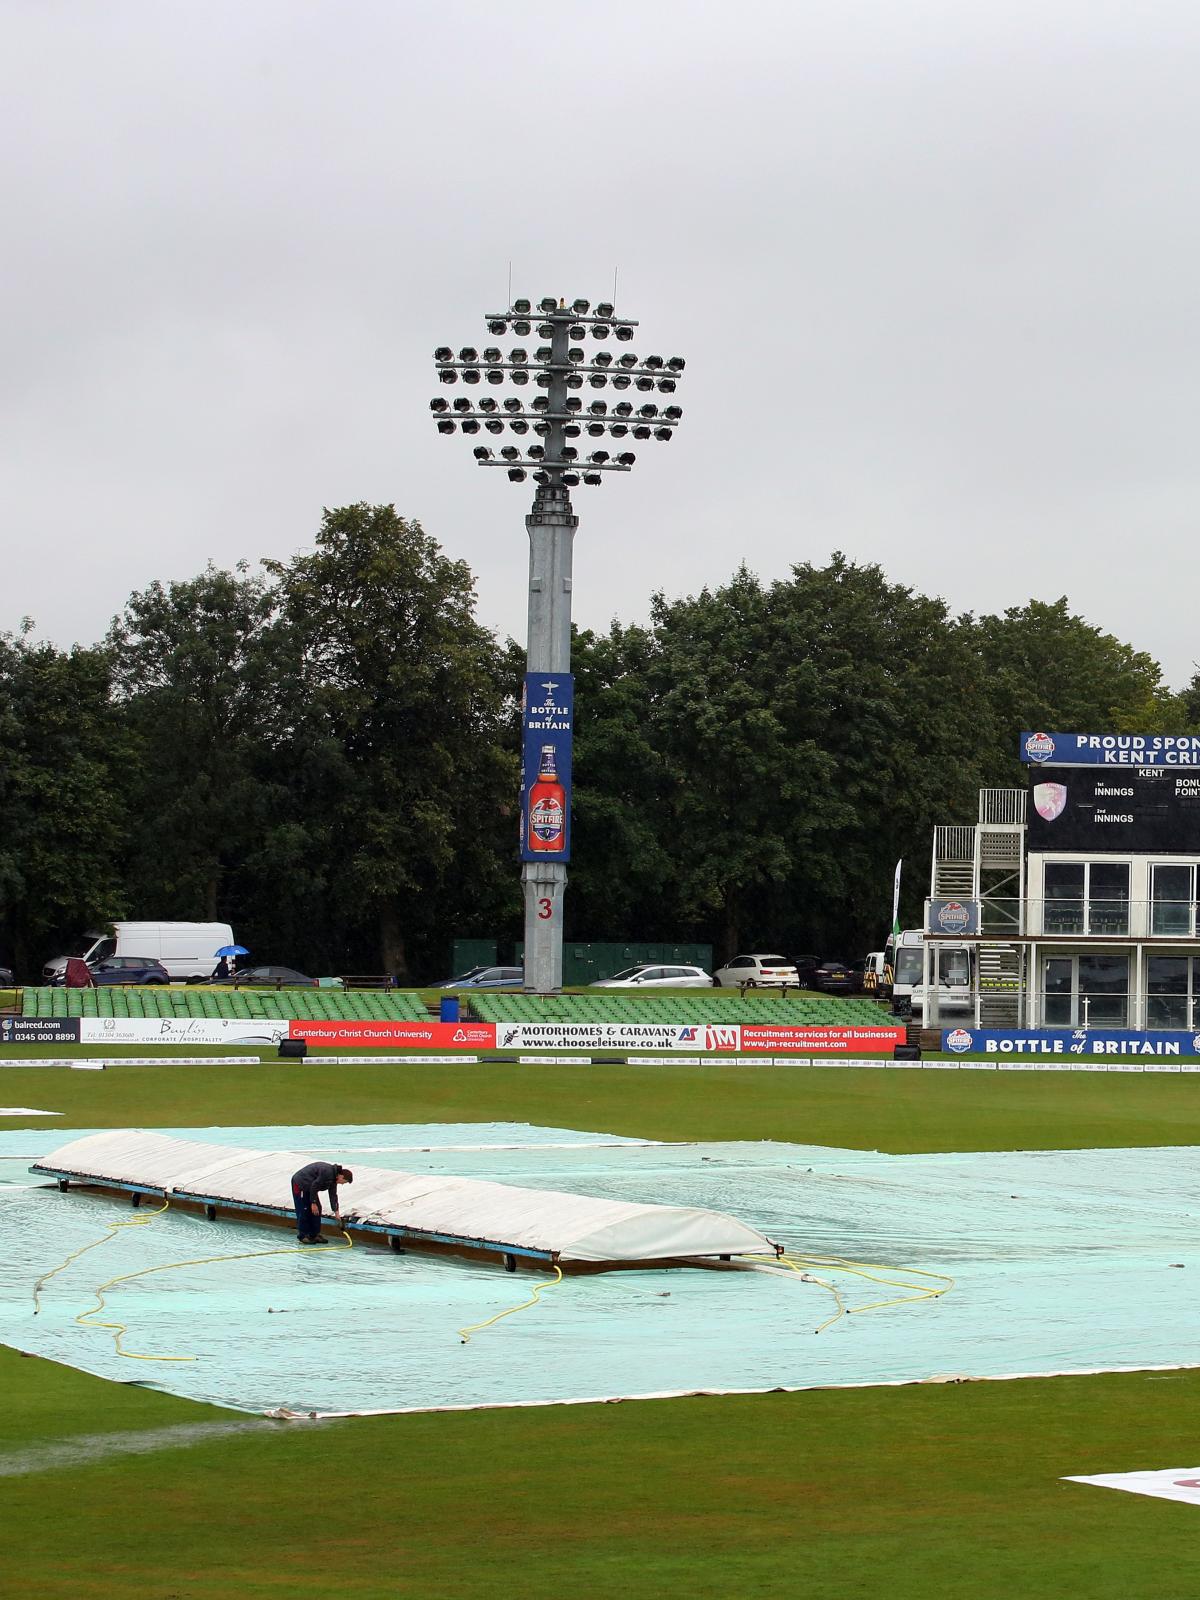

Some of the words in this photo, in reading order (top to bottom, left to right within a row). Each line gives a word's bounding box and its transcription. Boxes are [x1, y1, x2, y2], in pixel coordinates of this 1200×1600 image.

[531, 707, 569, 715] BOTTLE
[528, 722, 570, 730] BRITAIN
[1026, 743, 1055, 751] SPITFIRE
[1077, 735, 1146, 750] PROUD
[1104, 750, 1160, 764] KENT
[1139, 769, 1164, 778] KENT
[1094, 787, 1134, 797] INNINGS
[531, 813, 563, 824] SPITFIRE
[1094, 814, 1134, 823] INNINGS
[538, 898, 553, 920] 3
[940, 913, 967, 921] SPITFIRE
[292, 1029, 337, 1038] Canterbury
[338, 1029, 362, 1037] Christ
[363, 1029, 392, 1037] Church
[394, 1030, 432, 1040] University
[521, 1026, 603, 1036] MOTORHOMES
[606, 1026, 616, 1036] &
[620, 1027, 677, 1037] CARAVANS
[743, 1029, 793, 1038] Recruitment
[795, 1030, 828, 1038] services
[829, 1030, 841, 1038] for
[842, 1030, 852, 1038] all
[854, 1030, 897, 1039] businesses
[1072, 1030, 1087, 1039] The
[15, 1033, 36, 1041] 0345
[37, 1033, 54, 1041] 000
[55, 1033, 76, 1041] 8899
[523, 1037, 673, 1048] www.chooseleisure.co.uk
[743, 1040, 847, 1049] www.jm-recruitment.com
[985, 1039, 1064, 1053] BOTTLE
[1070, 1039, 1085, 1055] of
[1092, 1041, 1180, 1055] BRITAIN
